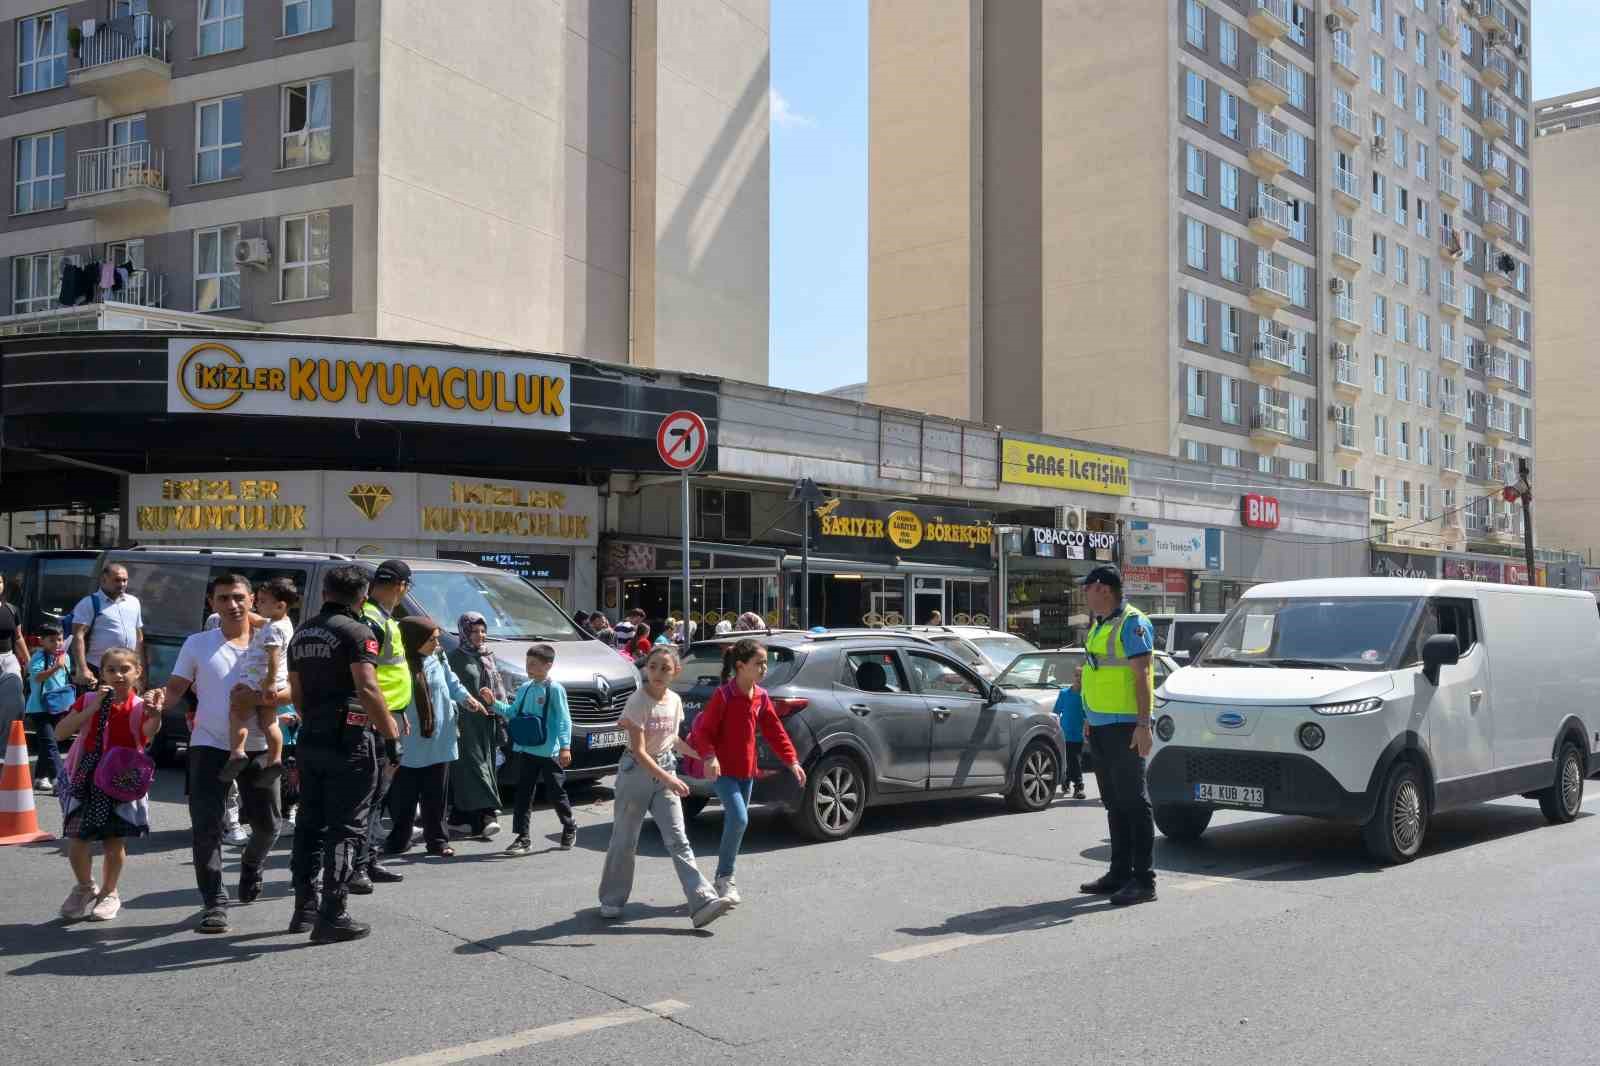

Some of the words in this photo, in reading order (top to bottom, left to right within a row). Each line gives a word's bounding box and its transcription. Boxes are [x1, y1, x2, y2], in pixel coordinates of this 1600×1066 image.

[195, 363, 286, 391] İKİZLER
[289, 357, 565, 416] KUYUMCULUK
[1069, 453, 1127, 488] İLETİŞİM
[136, 505, 306, 531] KUYUMCULUK
[423, 505, 589, 539] KUYUMCULUK
[821, 516, 884, 538] SARIYER
[1033, 528, 1085, 546] TOBACCO
[1089, 533, 1115, 548] SHOP
[1201, 785, 1213, 799] 34
[1243, 788, 1263, 802] 213
